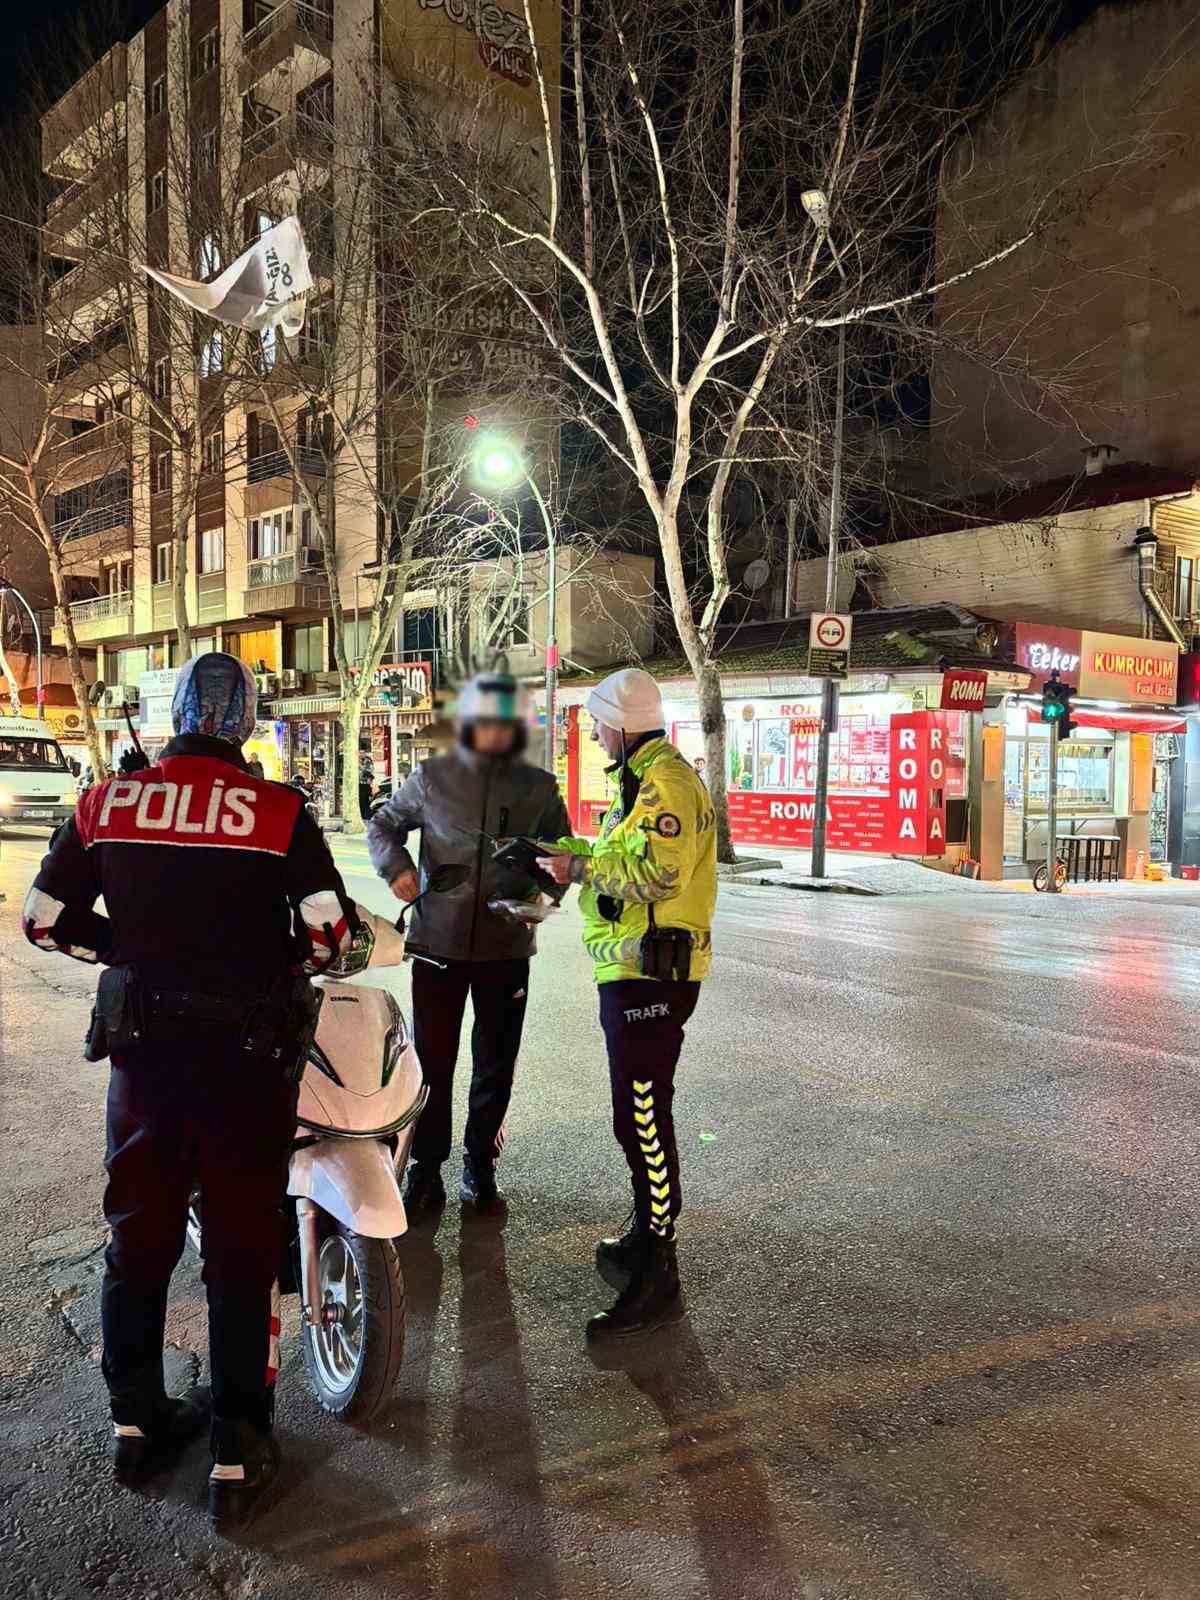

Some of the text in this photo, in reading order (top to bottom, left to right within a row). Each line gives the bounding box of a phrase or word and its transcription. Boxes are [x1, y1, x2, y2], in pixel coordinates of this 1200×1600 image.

[950, 679, 985, 702] ROMA
[1094, 653, 1174, 679] KUMRUCUM
[99, 778, 257, 837] POLİS
[898, 728, 918, 839] ROMA
[929, 727, 944, 839] ROMA
